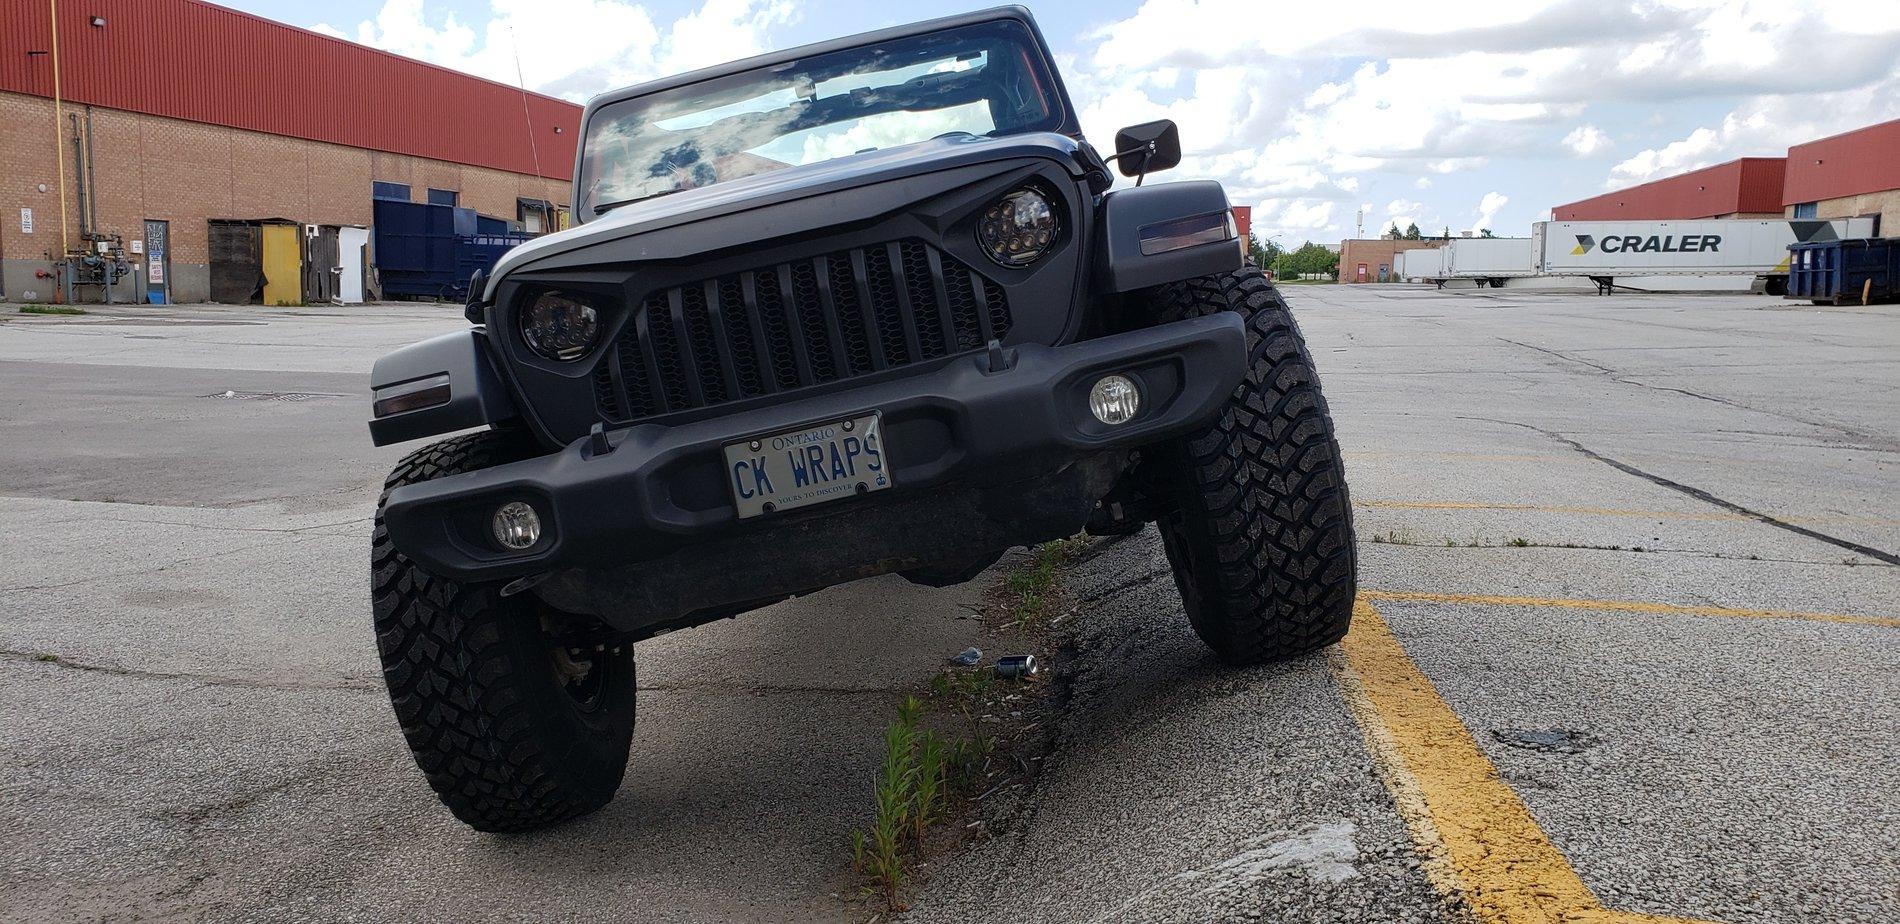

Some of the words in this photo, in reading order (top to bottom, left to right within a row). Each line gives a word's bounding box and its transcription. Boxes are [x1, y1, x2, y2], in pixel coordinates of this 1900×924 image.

[1600, 235, 1722, 254] CRALER
[772, 428, 835, 451] ONTARIO
[734, 456, 775, 499] CK
[788, 433, 882, 488] WRAPS
[778, 495, 803, 504] YOURS
[804, 490, 815, 499] TO
[816, 483, 853, 496] DISCOVER
